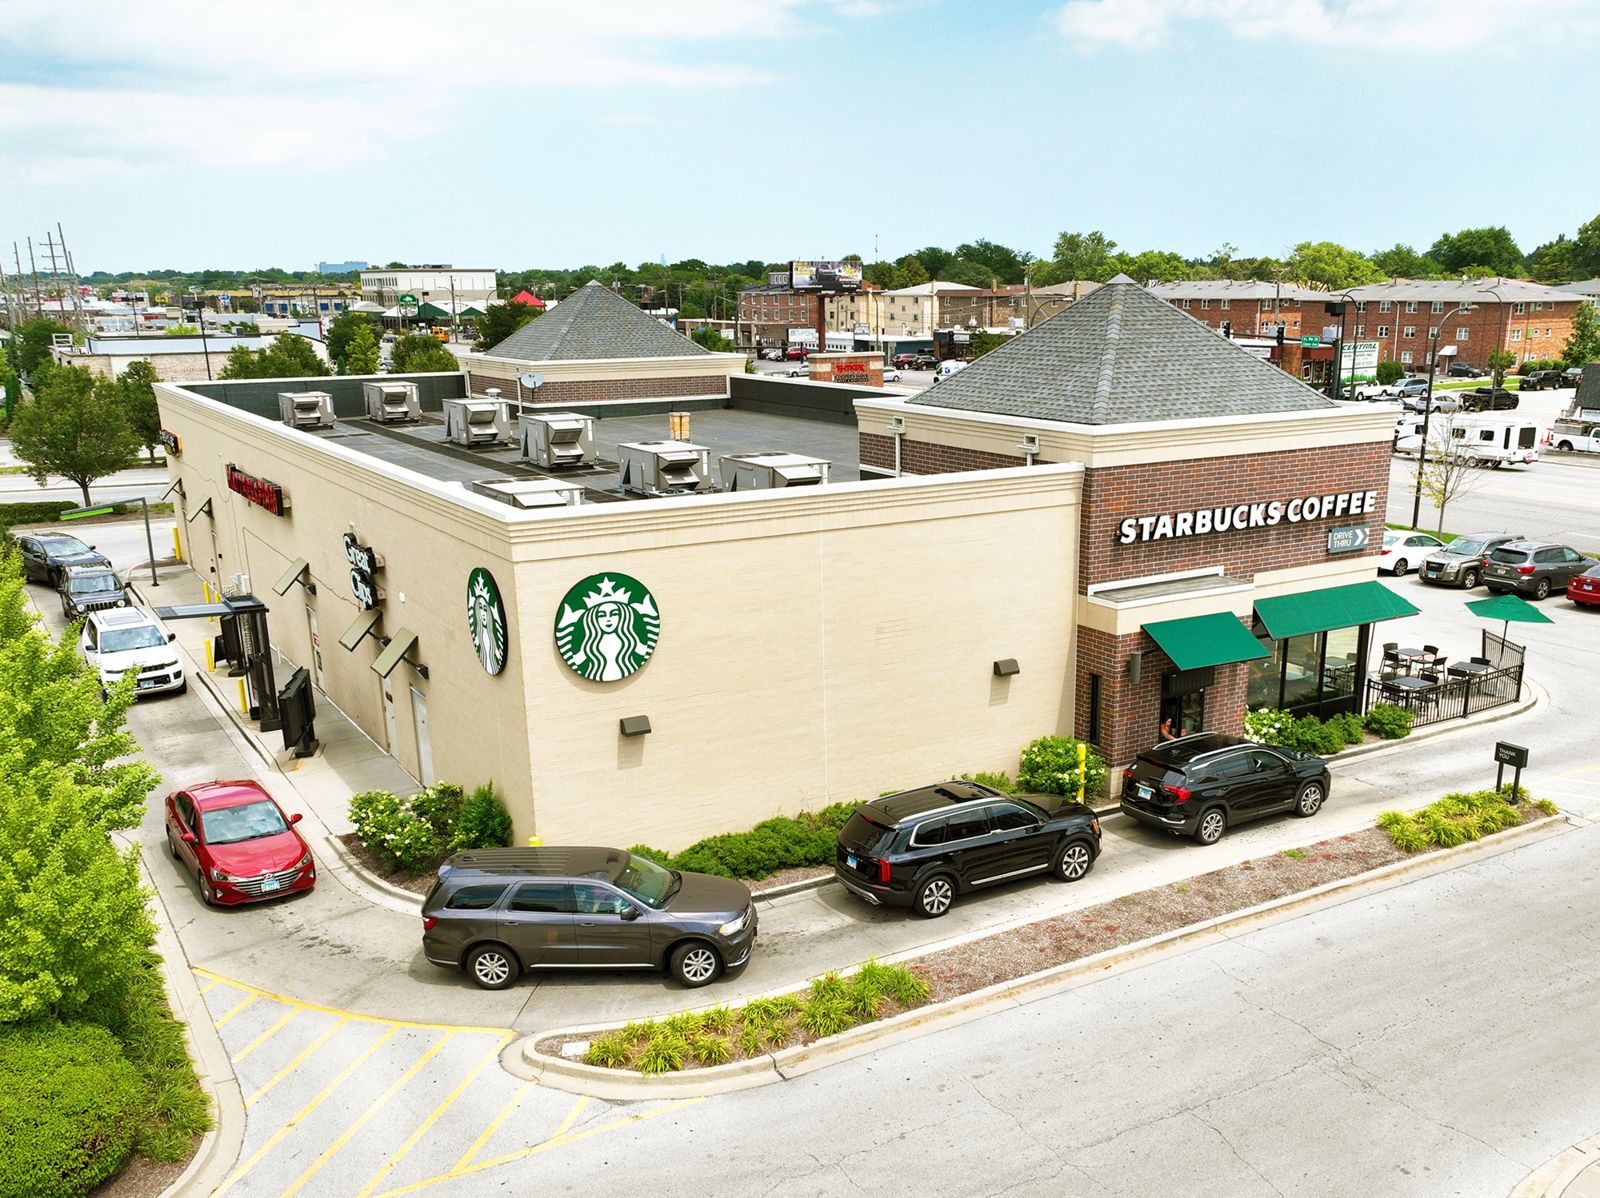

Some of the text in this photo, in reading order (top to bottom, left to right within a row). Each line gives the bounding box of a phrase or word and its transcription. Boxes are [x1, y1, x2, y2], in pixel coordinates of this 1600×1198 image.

[1342, 343, 1377, 351] CENTRAL
[1120, 490, 1377, 544] STARBUCKS COFFEE
[1333, 530, 1353, 541] DRIVE
[1333, 539, 1352, 548] THRU
[343, 535, 371, 575] Great
[351, 570, 373, 609] Clips
[1498, 748, 1516, 757] THANK
